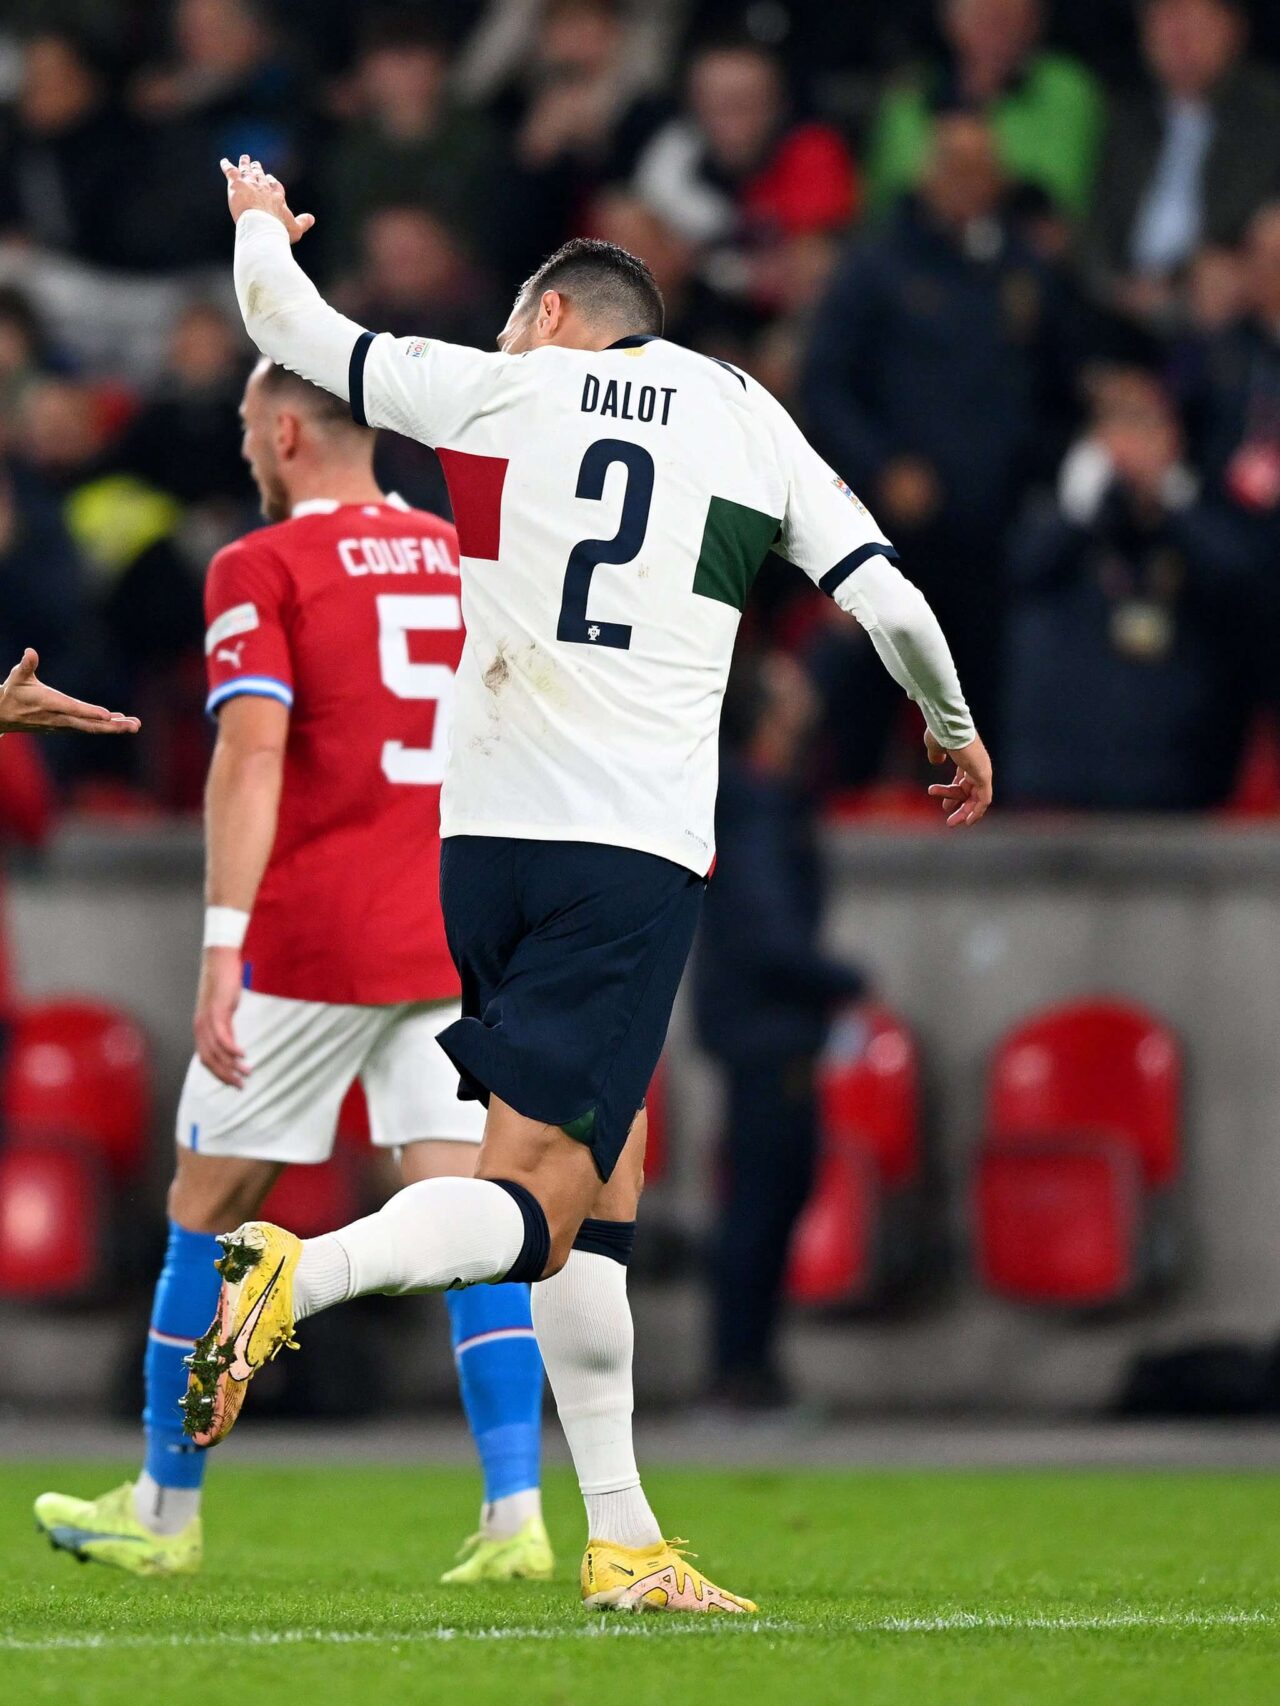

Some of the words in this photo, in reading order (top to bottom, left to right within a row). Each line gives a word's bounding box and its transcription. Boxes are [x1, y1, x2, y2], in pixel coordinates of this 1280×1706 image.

[580, 373, 678, 426] DALOT
[337, 536, 460, 577] COUFAL
[556, 438, 655, 650] 2
[376, 594, 462, 785] 5
